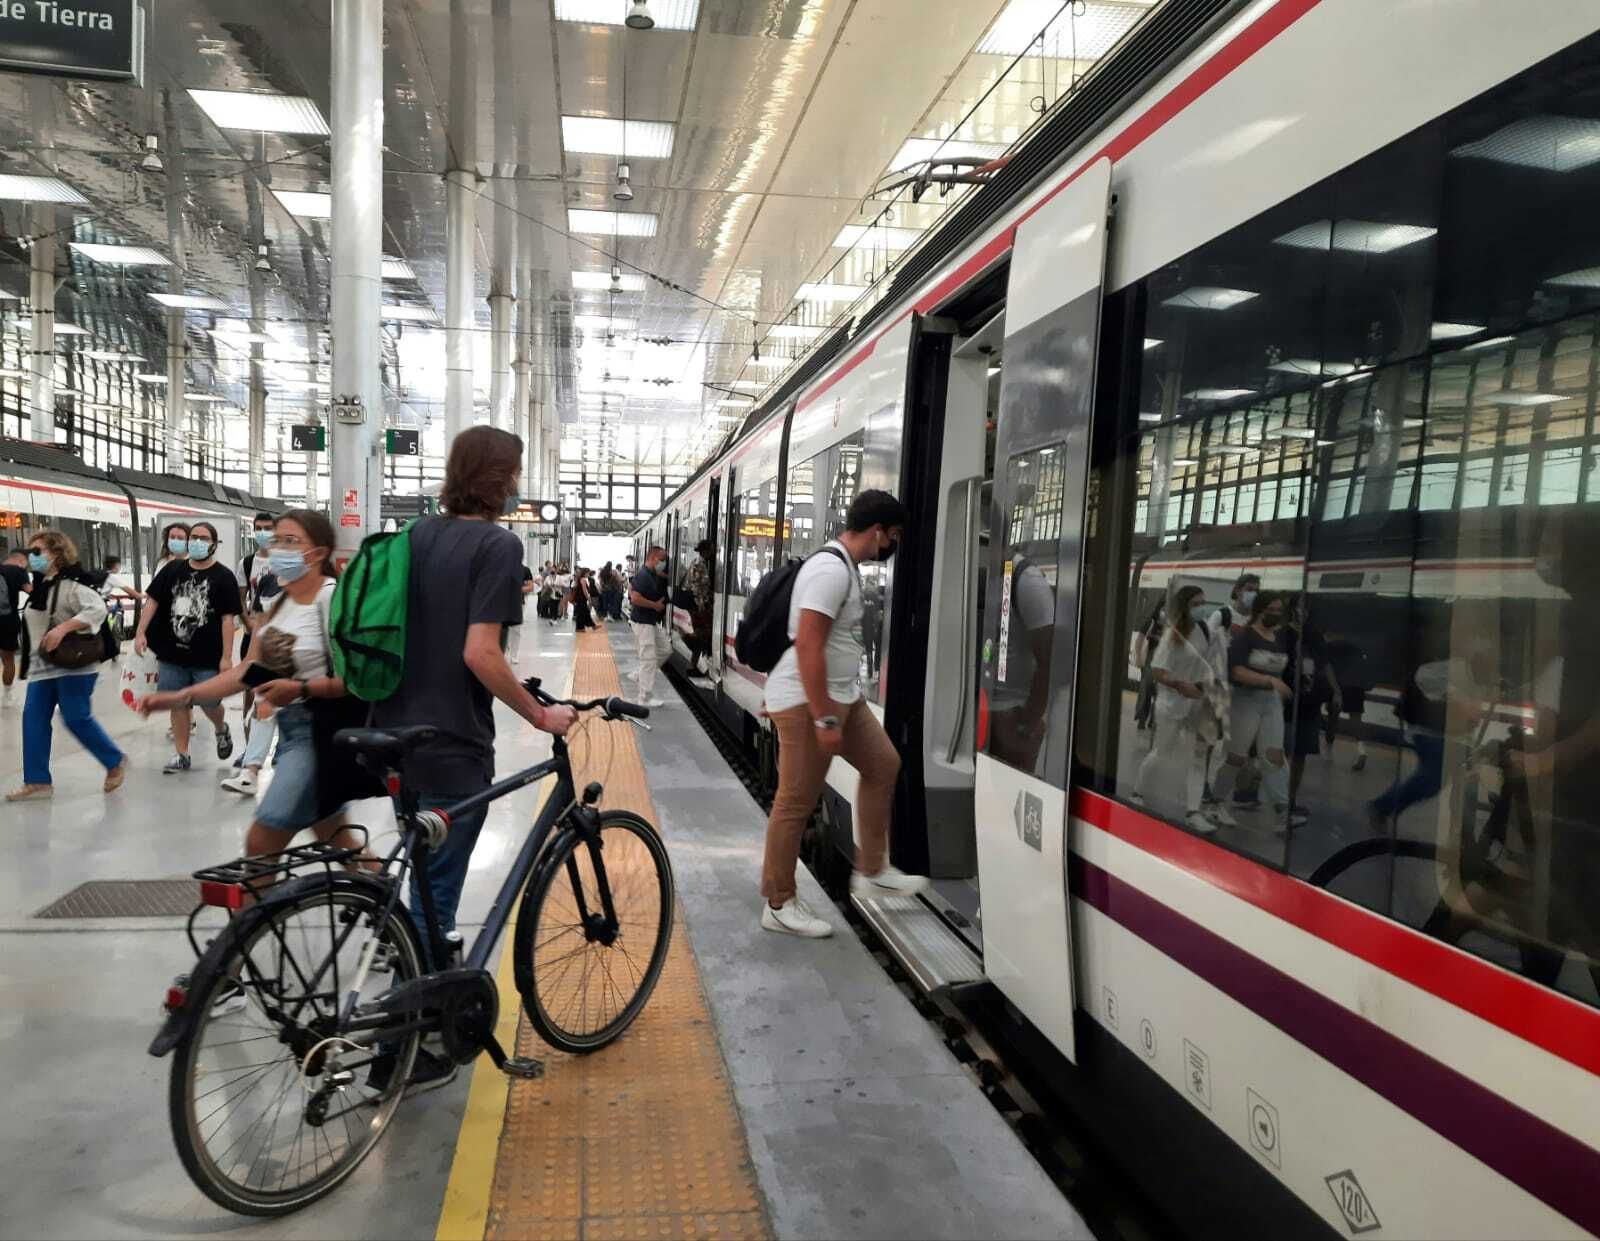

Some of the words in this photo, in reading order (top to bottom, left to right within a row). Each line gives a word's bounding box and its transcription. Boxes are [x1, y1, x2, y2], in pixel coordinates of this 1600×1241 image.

[35, 1, 113, 30] Tierra
[293, 437, 302, 449] 4
[409, 442, 417, 454] 5
[1107, 997, 1115, 1020] E
[1145, 1026, 1153, 1050] D
[1340, 1178, 1362, 1223] 120
